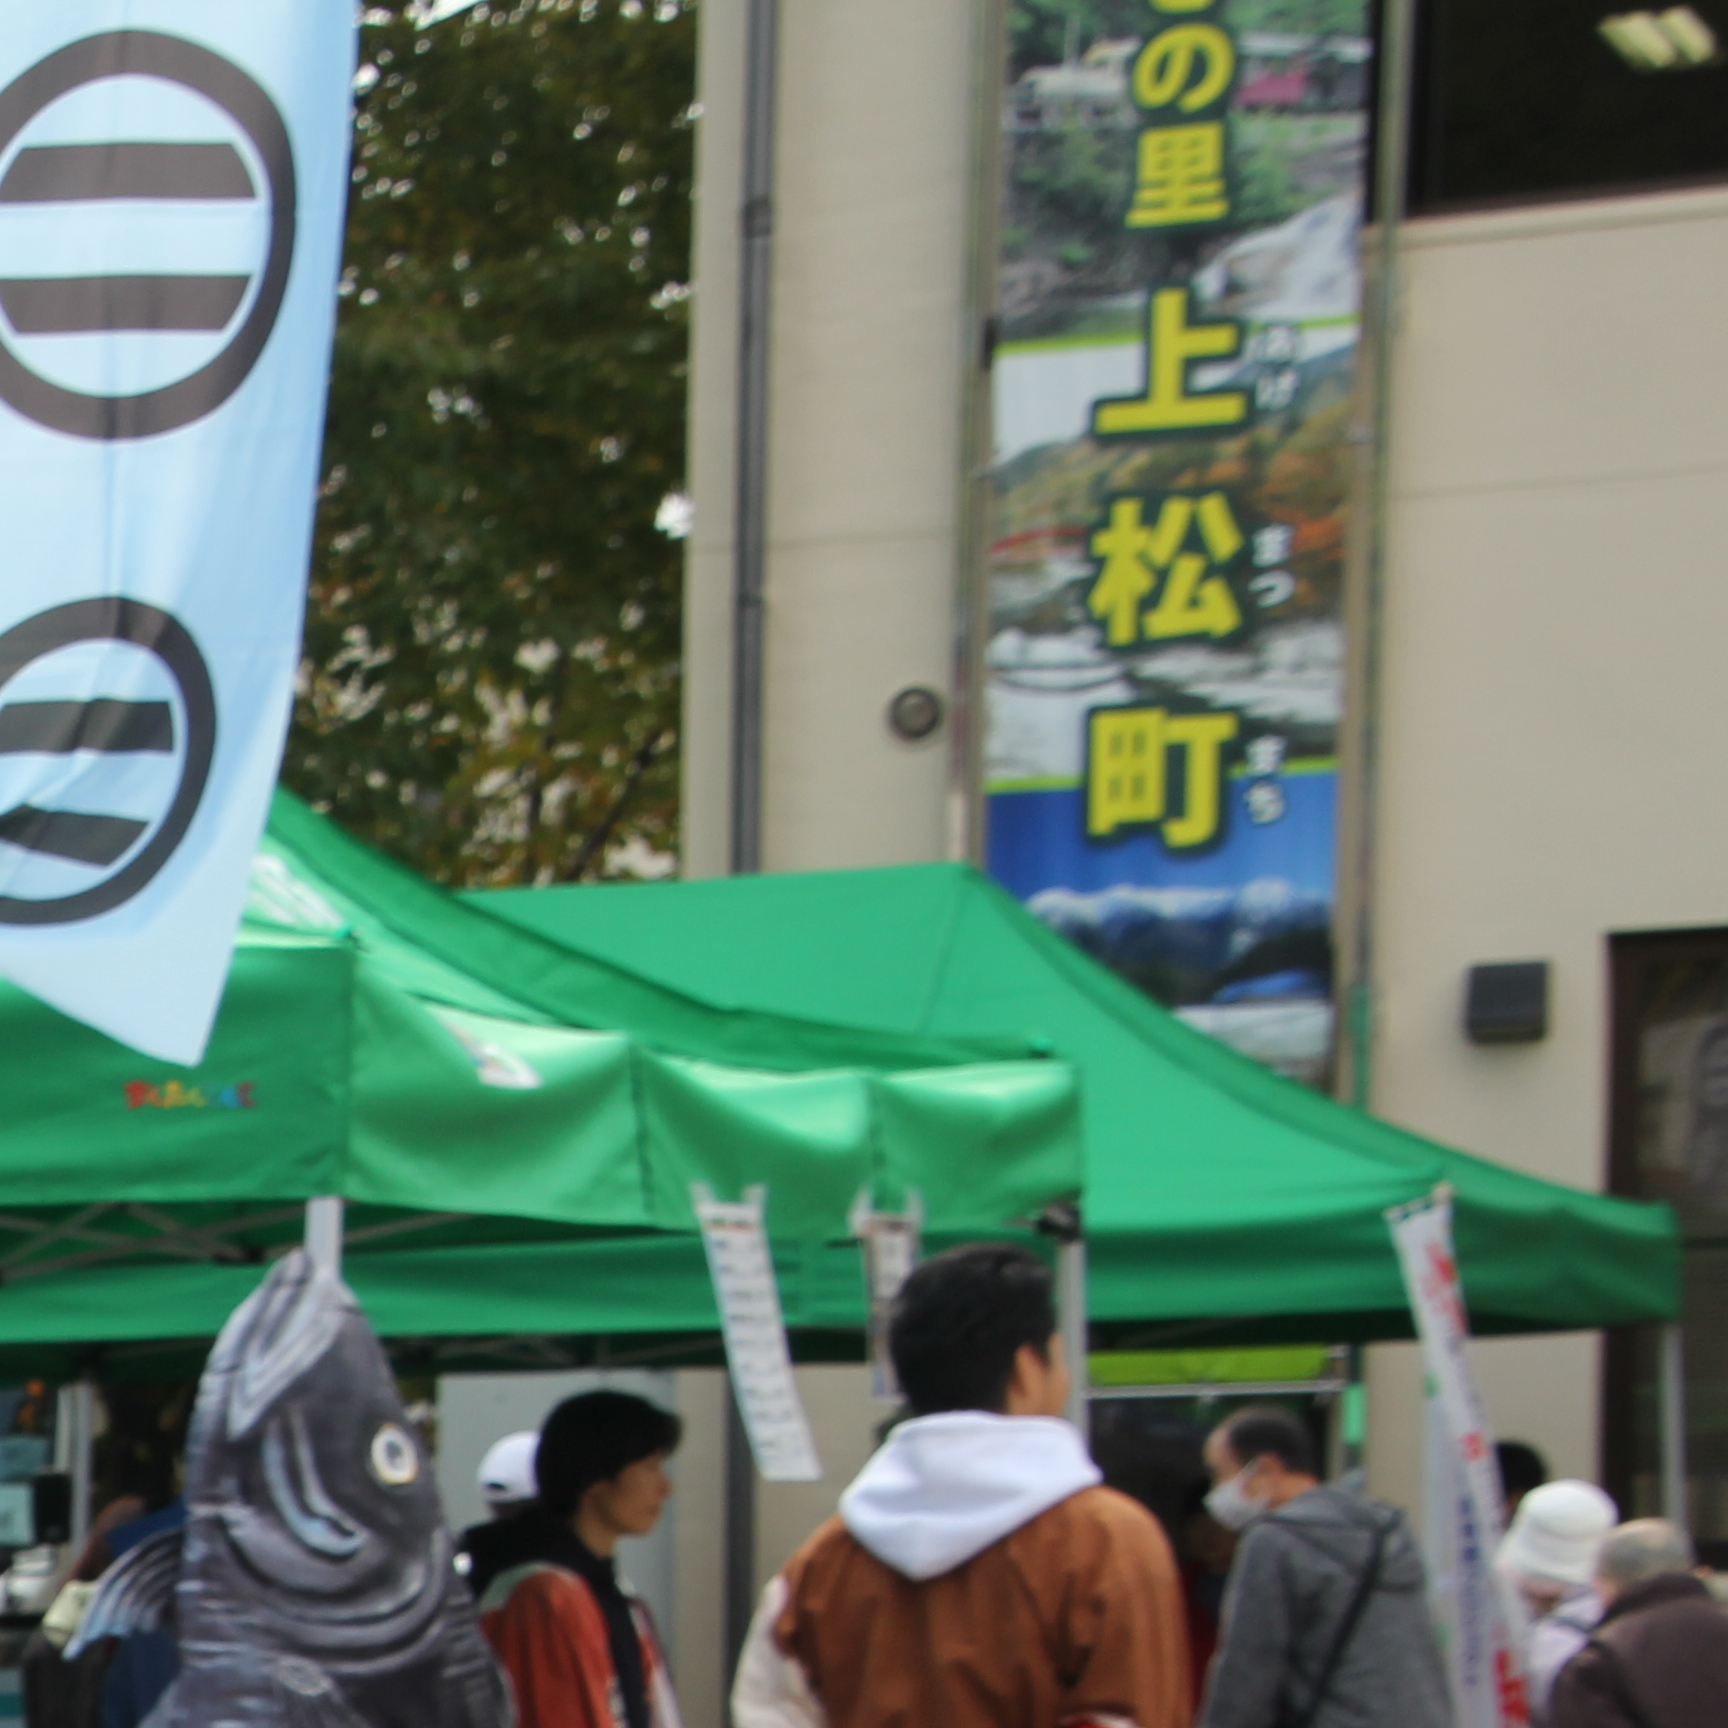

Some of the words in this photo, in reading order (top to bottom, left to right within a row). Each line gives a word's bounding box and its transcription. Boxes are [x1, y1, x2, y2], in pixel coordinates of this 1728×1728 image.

[1125, 0, 1235, 228] の里
[1085, 288, 1248, 849] 上松町
